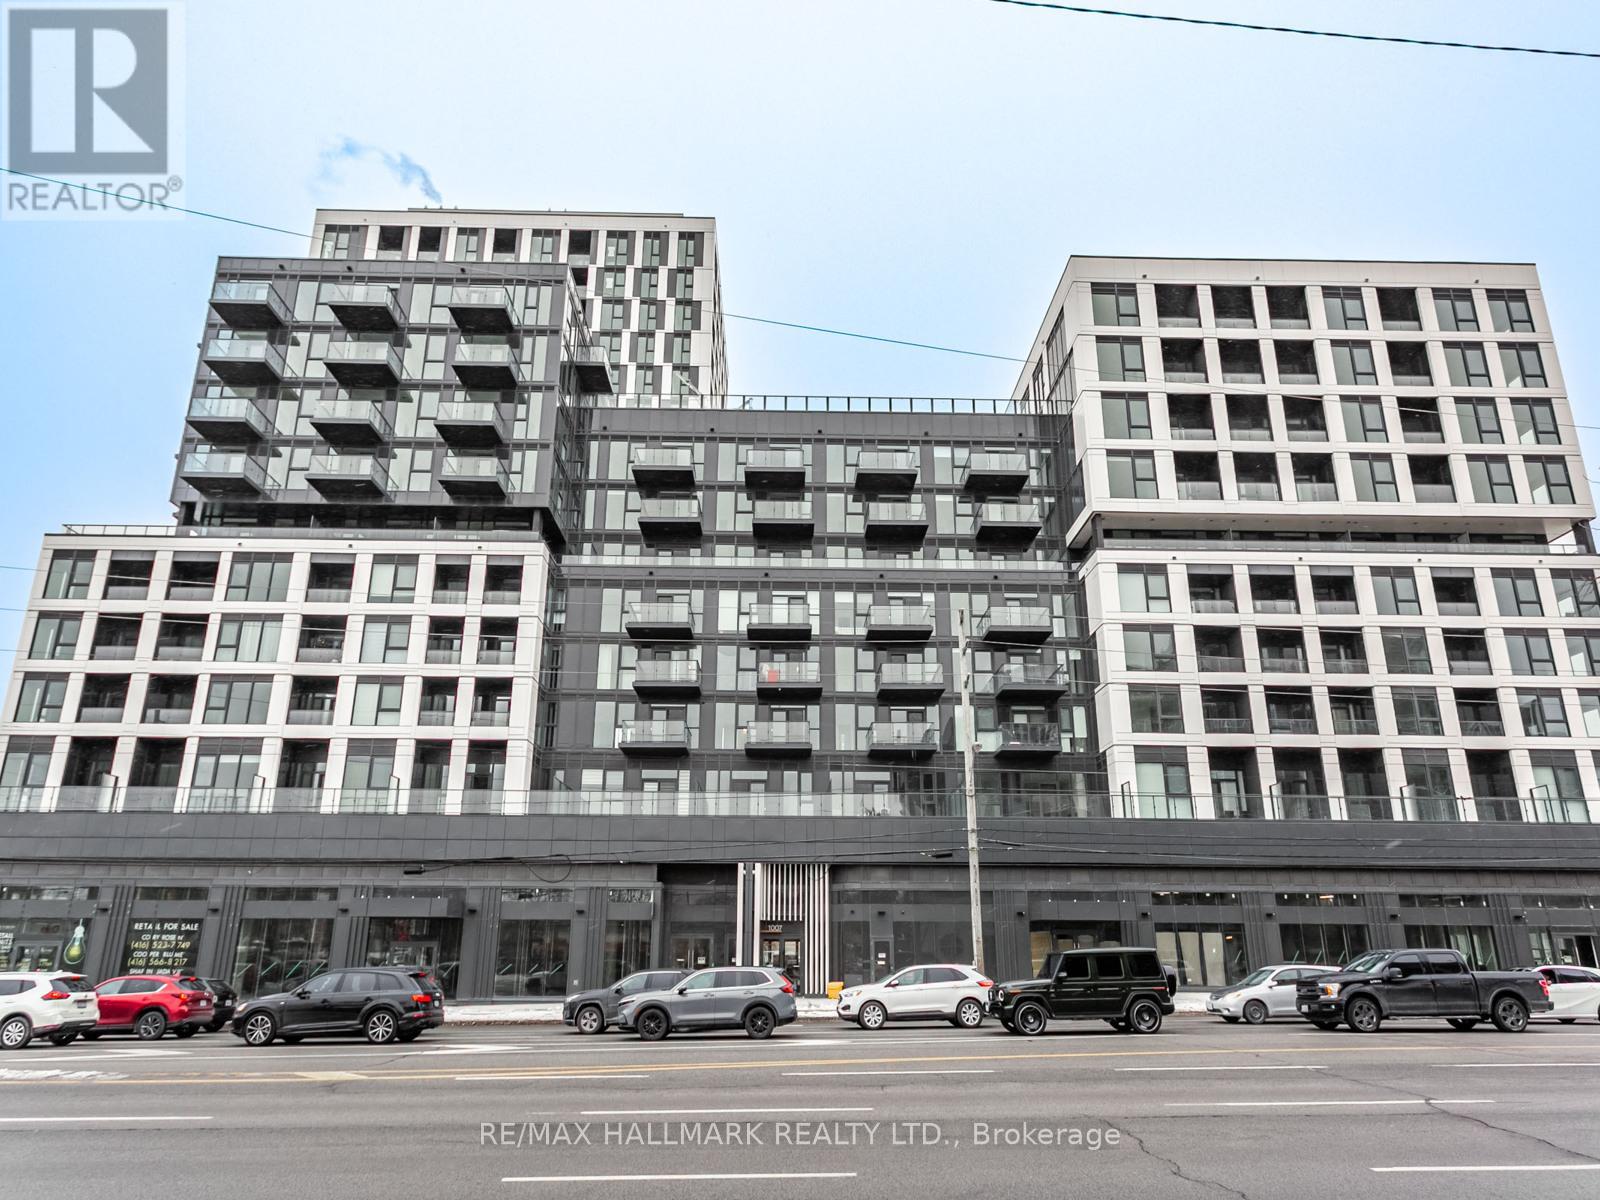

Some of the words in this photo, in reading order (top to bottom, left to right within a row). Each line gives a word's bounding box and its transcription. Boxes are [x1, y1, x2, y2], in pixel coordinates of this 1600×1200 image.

[181, 923, 199, 931] SALE
[131, 941, 149, 949] (416)
[128, 958, 146, 966] (416)
